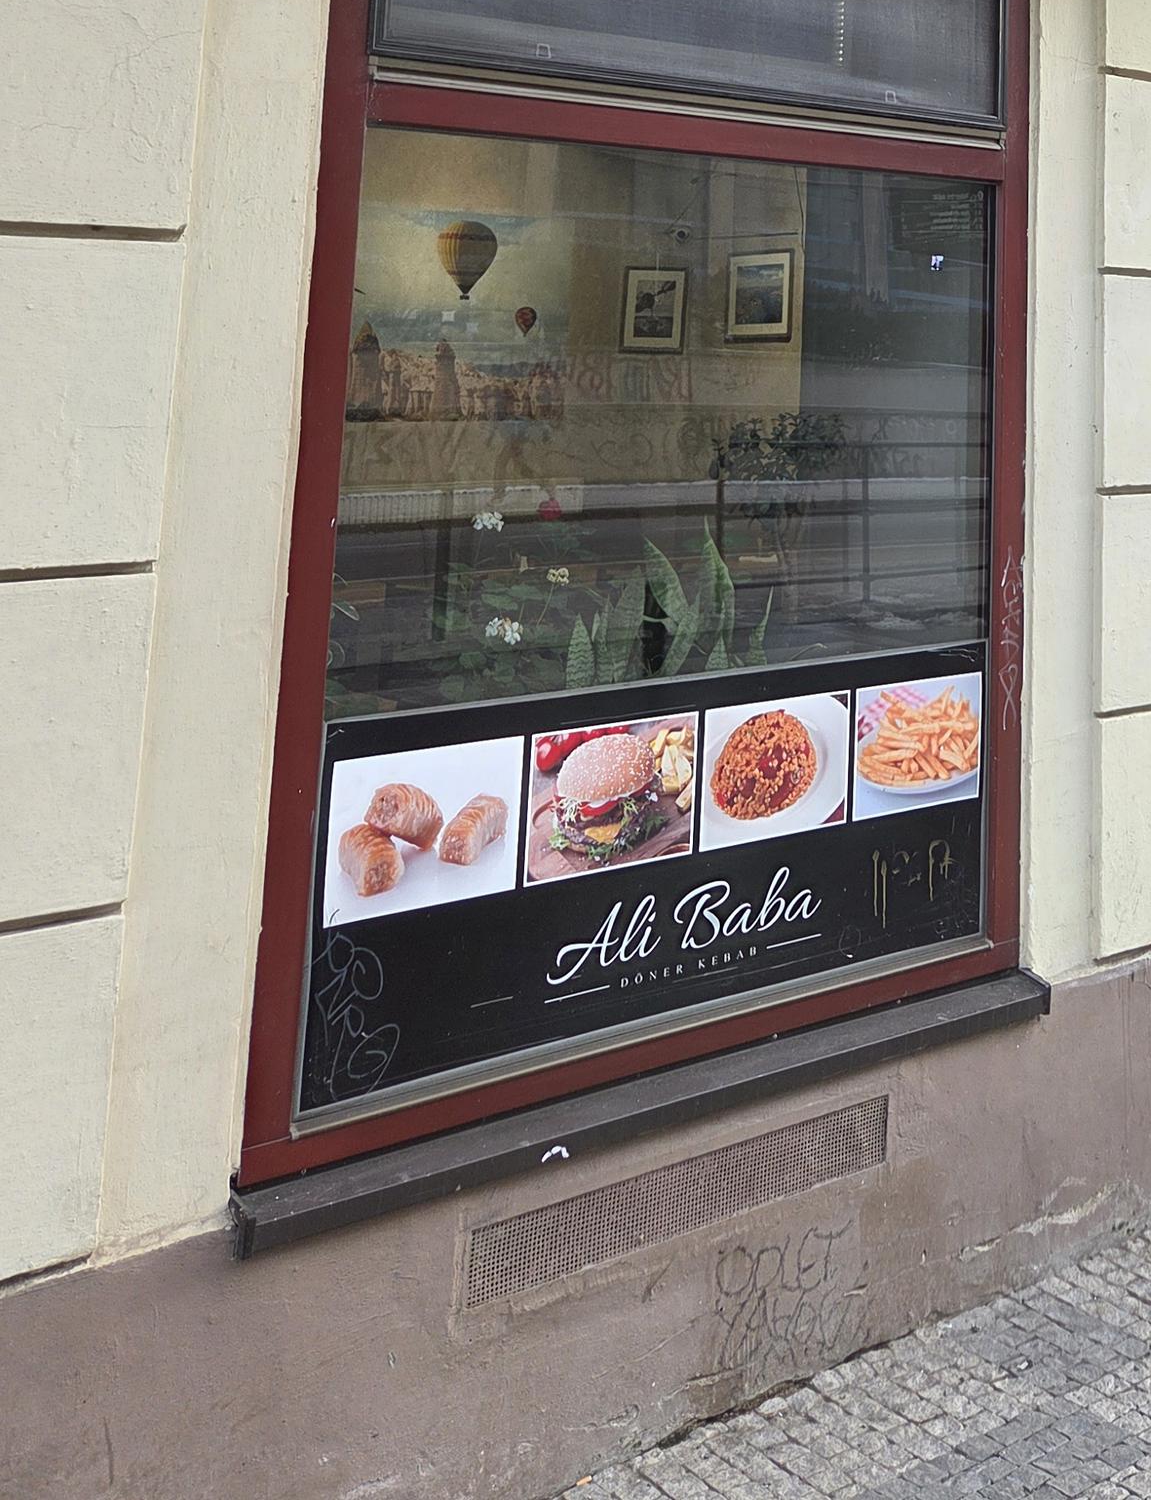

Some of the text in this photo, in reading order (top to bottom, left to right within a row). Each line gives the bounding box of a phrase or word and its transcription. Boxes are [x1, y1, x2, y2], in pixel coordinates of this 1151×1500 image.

[546, 894, 662, 986] Ali
[673, 866, 822, 950] Baba
[619, 945, 759, 989] DÖNER KEBAB
